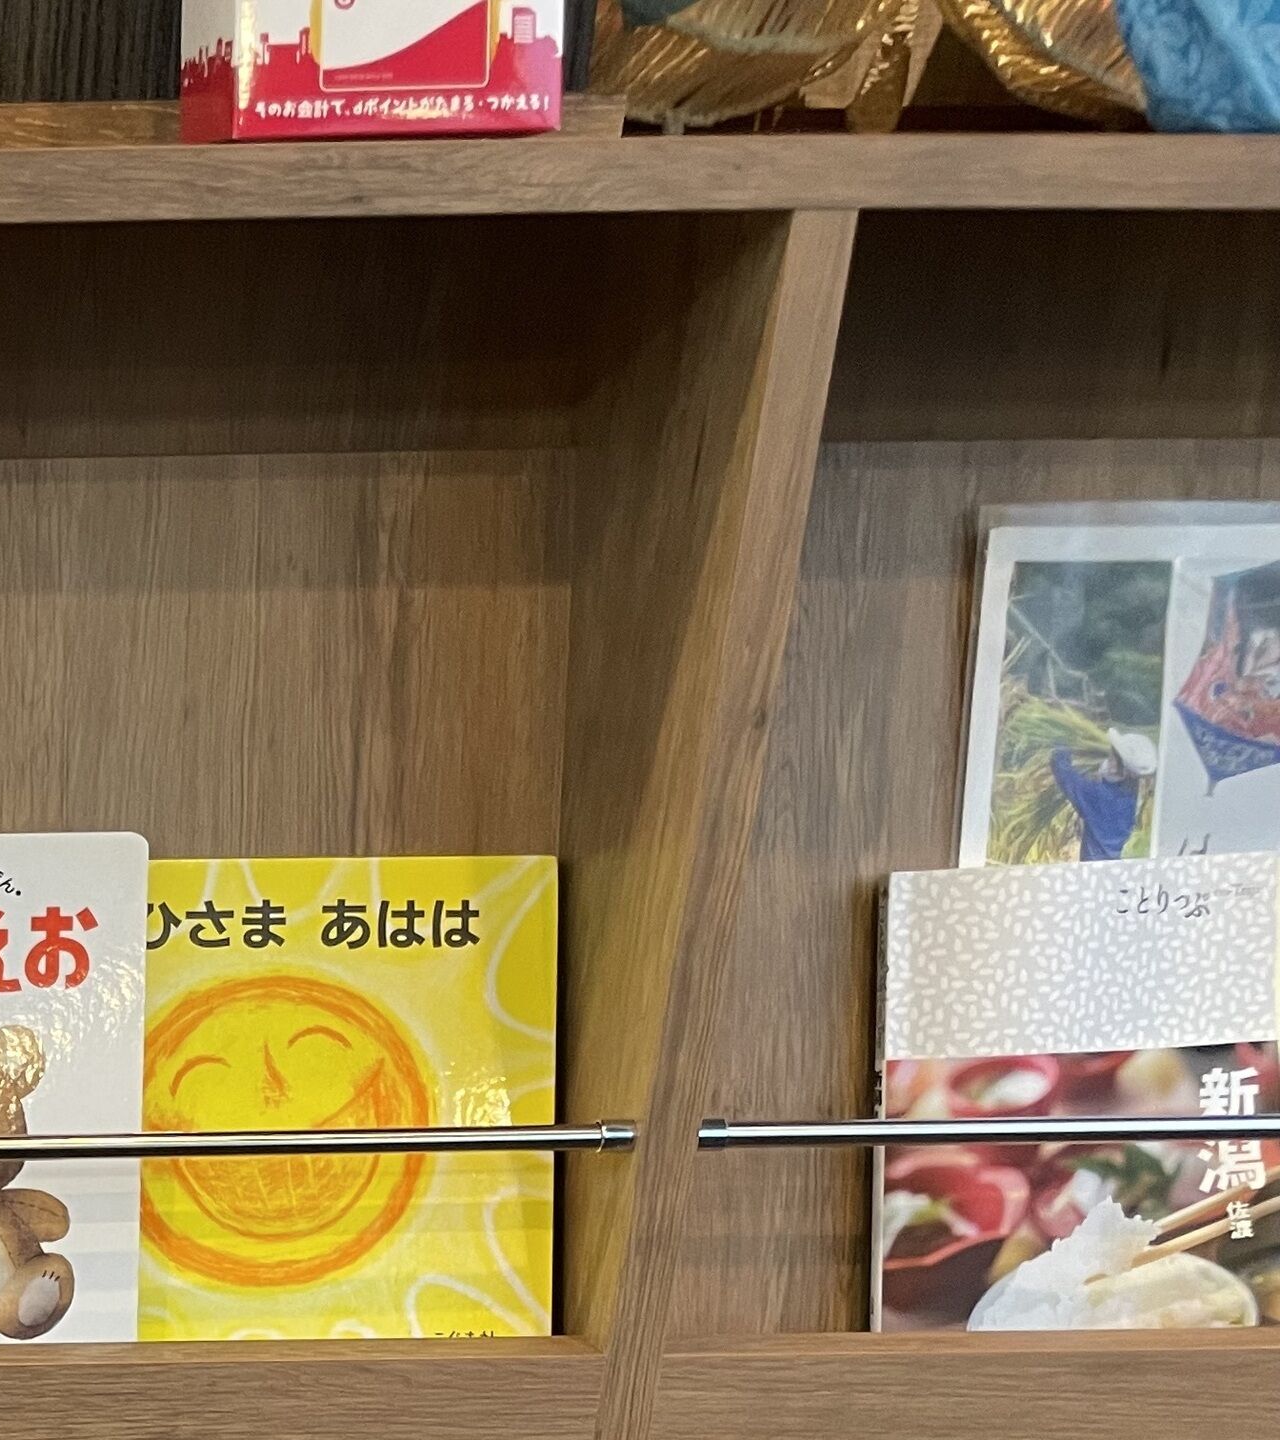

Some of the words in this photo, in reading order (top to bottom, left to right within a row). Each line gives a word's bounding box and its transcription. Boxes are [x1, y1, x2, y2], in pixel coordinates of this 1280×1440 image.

[321, 899, 480, 950] あはは
[1197, 1067, 1267, 1193] 新潟
